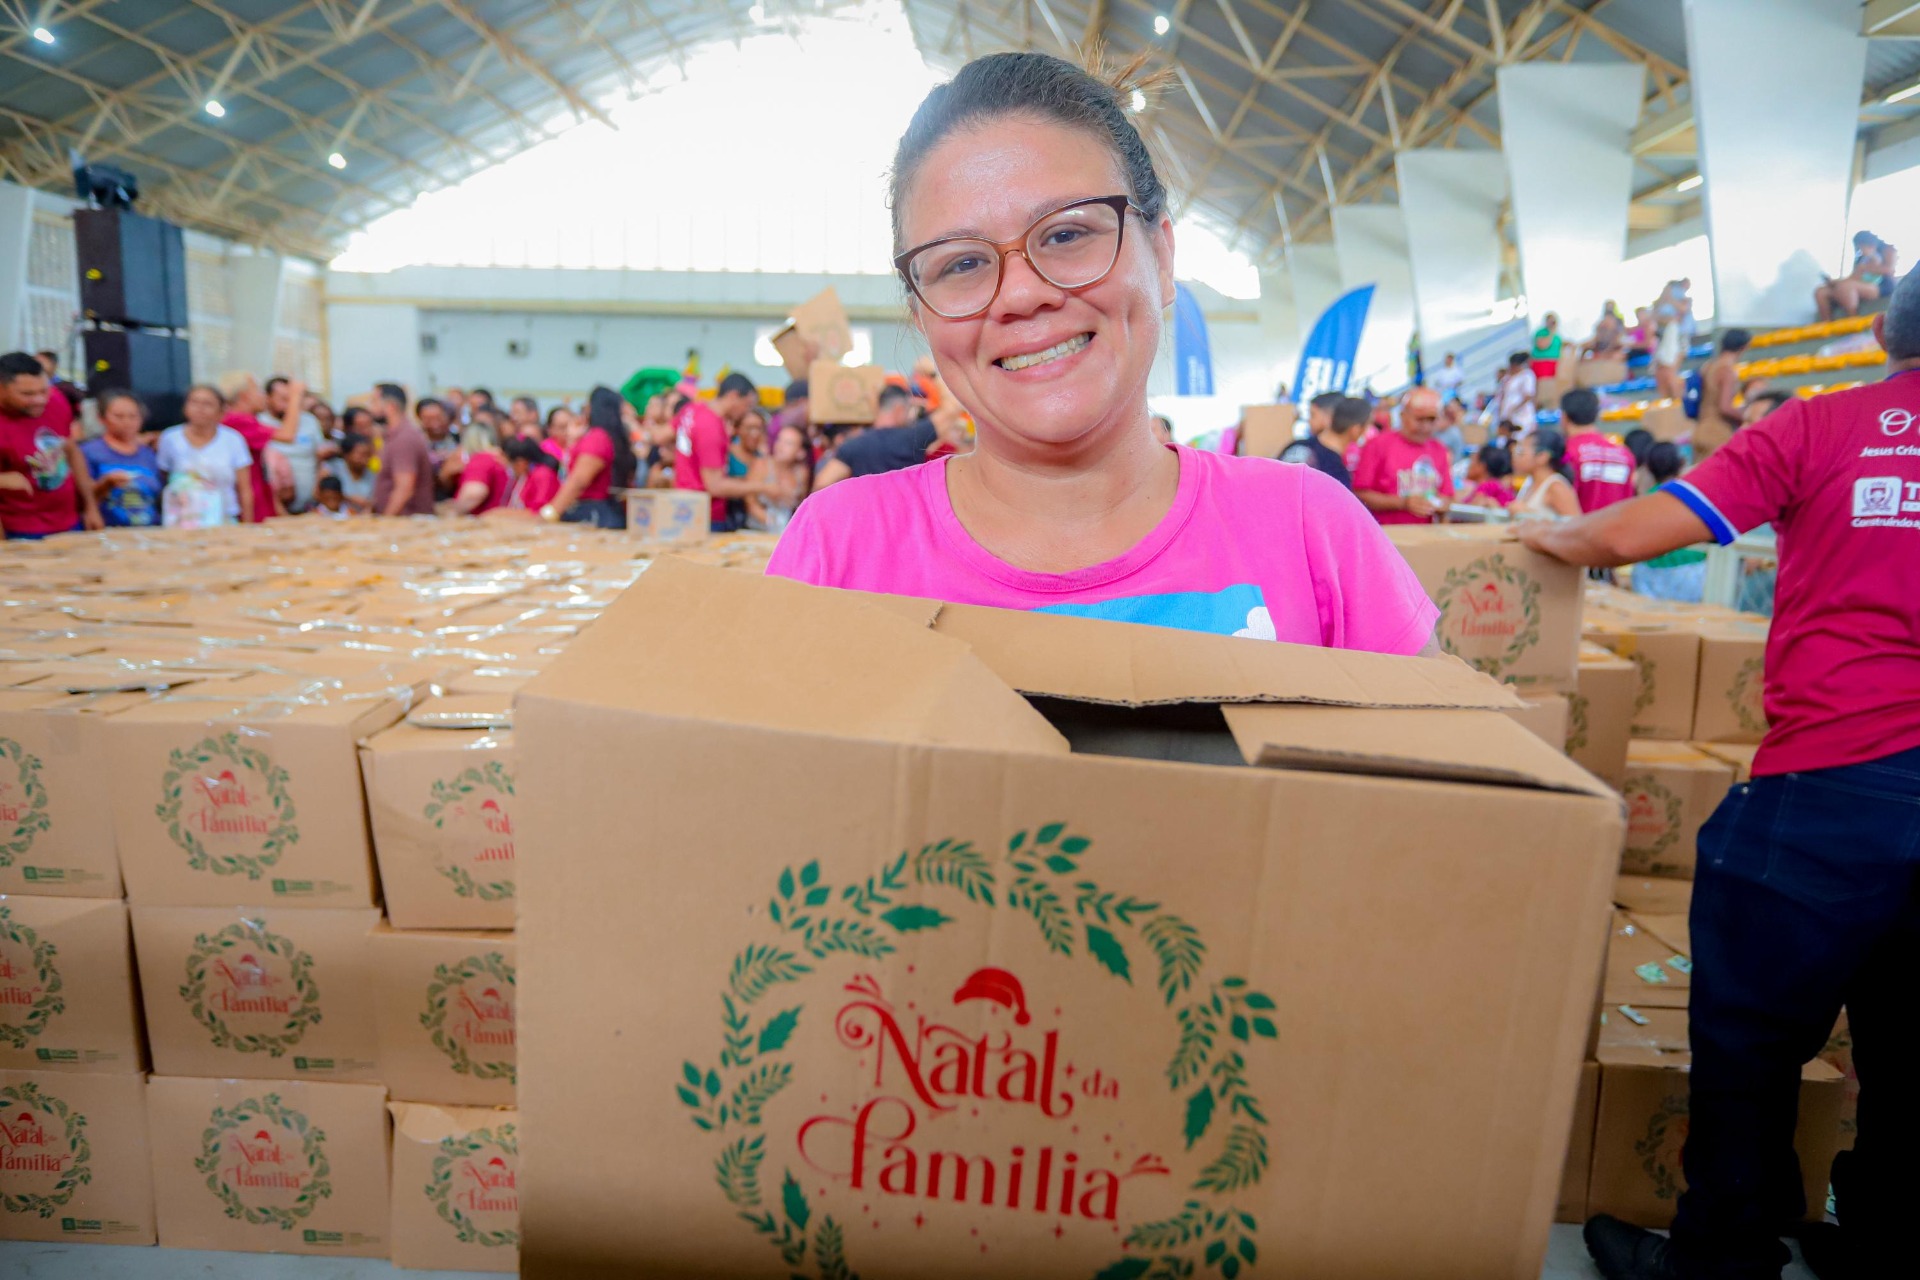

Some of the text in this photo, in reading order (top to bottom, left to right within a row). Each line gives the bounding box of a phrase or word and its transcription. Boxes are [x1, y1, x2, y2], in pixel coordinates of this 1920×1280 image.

[1859, 444, 1920, 457] Jesus Cris
[836, 985, 1119, 1119] Natal da
